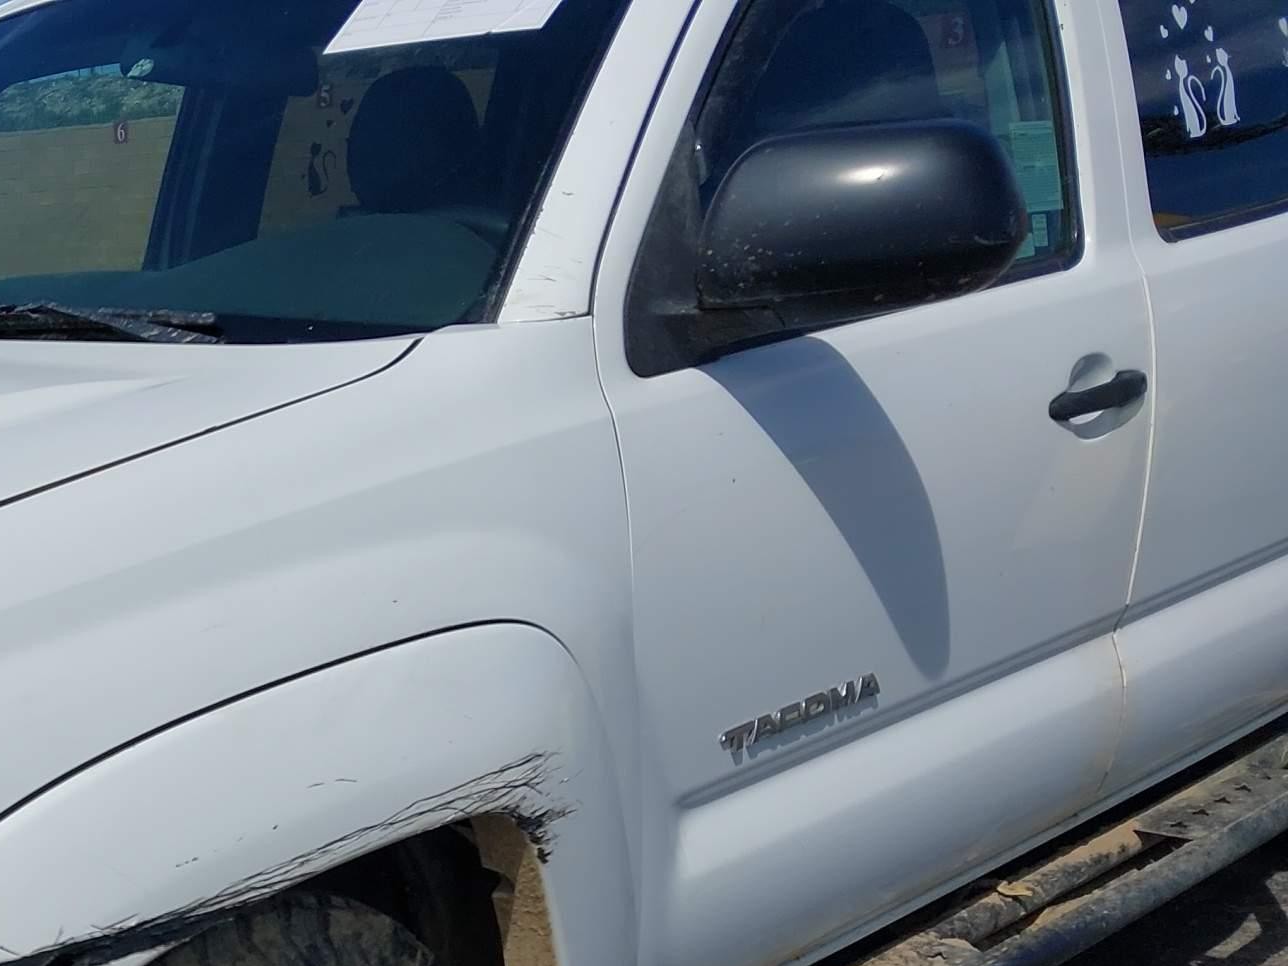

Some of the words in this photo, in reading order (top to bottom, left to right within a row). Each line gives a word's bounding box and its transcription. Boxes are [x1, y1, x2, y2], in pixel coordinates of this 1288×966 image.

[320, 84, 330, 107] 5
[117, 123, 125, 142] 6
[719, 672, 880, 751] TACOMA
